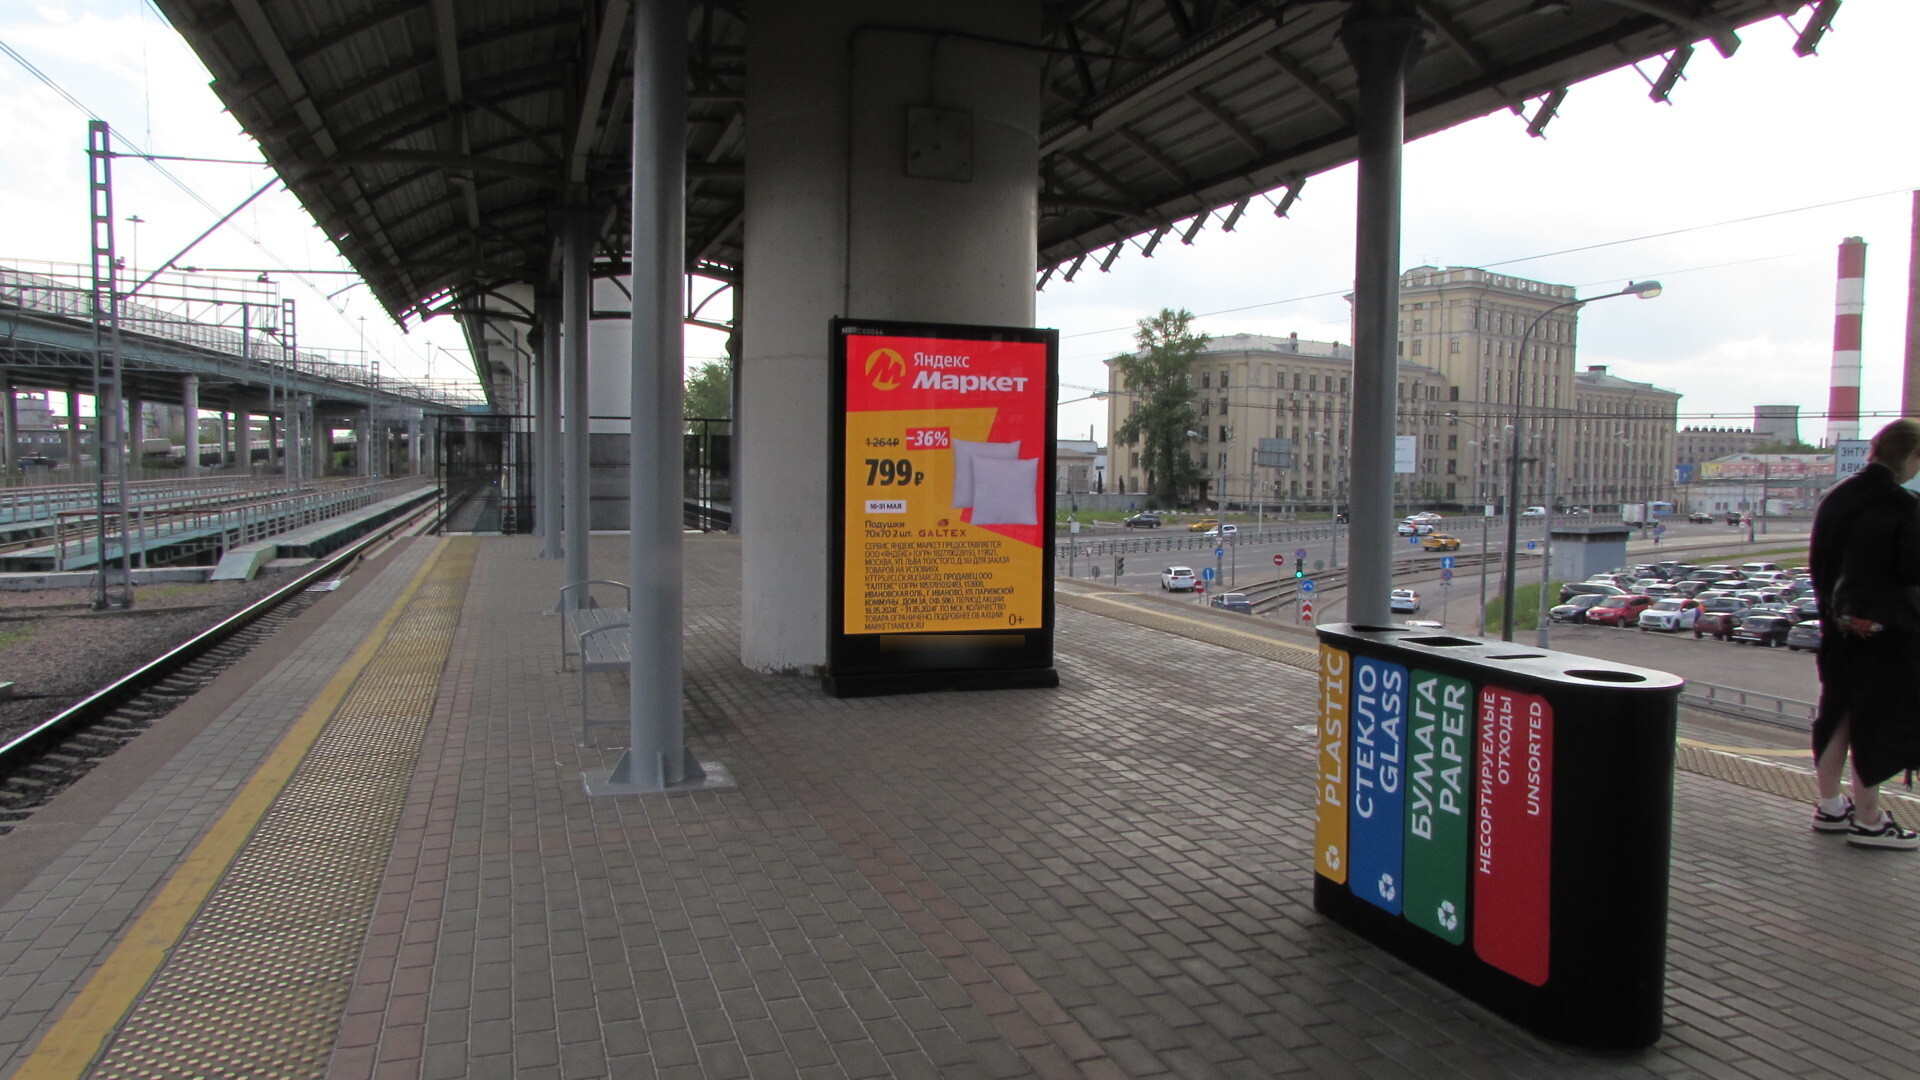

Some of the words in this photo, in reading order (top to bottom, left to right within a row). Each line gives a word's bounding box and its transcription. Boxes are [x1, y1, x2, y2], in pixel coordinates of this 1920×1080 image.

[914, 352, 970, 368] Яндекс
[912, 371, 1028, 394] Маркет
[1841, 447, 1870, 457] ЭНТУ
[1841, 463, 1865, 472] АВИ
[865, 520, 905, 529] Подушки
[919, 529, 966, 537] GALTEX
[975, 586, 1014, 595] ПАРИЖСКОЙ
[934, 612, 970, 620] ПОДРОБНЕЕ
[1009, 613, 1024, 626] 0+
[1326, 653, 1343, 807] PLASTIC
[1355, 664, 1377, 818] СТЕКЛО
[1380, 669, 1402, 793] GLASS
[1498, 696, 1513, 784] ОТХОДЫ
[1412, 678, 1438, 840] БУМАГА
[1439, 684, 1466, 816] PAPER
[1528, 701, 1542, 816] UNSORTED
[1480, 692, 1495, 874] НЕСОРТИРУЕМЫЕ
